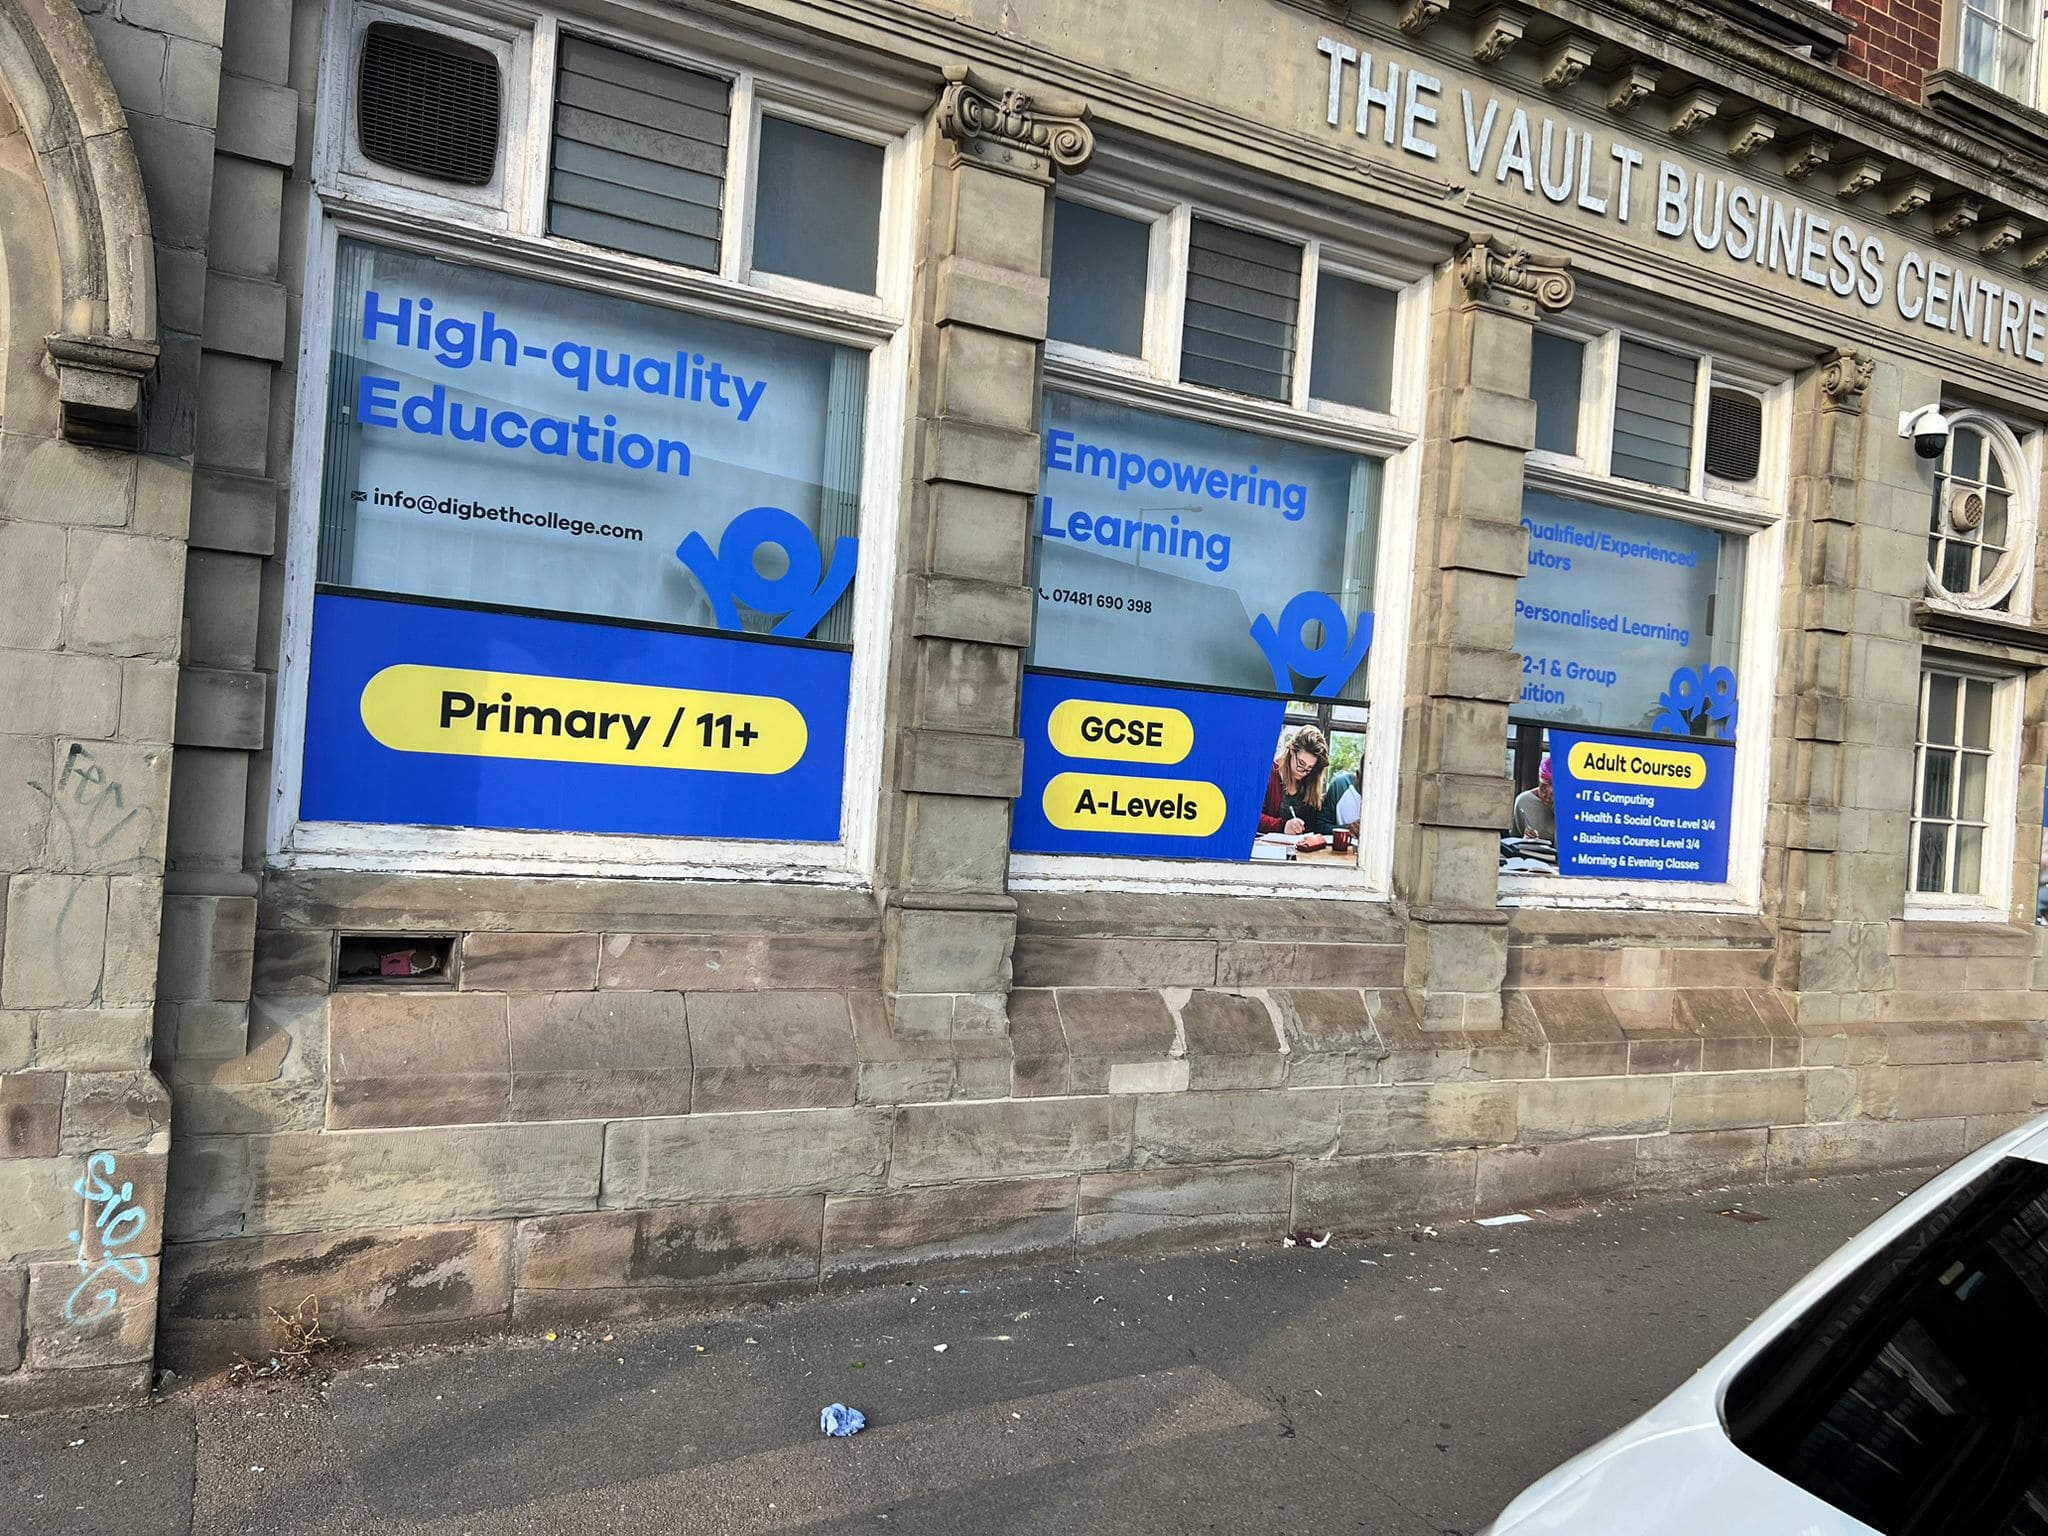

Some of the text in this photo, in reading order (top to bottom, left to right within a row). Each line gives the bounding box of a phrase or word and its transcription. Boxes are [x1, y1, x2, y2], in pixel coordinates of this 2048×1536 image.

[1317, 35, 2048, 363] THE VAULT BUSINESS CENTRE
[362, 290, 768, 422] High-quality
[356, 374, 693, 478] Education
[1046, 428, 1308, 523] Empowering
[373, 487, 644, 542] info@digbethcollege.com
[1041, 496, 1233, 574] Learning
[1528, 549, 1573, 572] utors
[1052, 588, 1153, 614] 07481 690 398
[1515, 599, 1691, 647] Personalised Learning
[1522, 655, 1617, 688] 2-1 & Group
[1520, 682, 1565, 705] uition
[439, 690, 759, 751] Primary / 11+
[1080, 716, 1164, 748] GCSE
[1583, 752, 1692, 779] Adult Courses
[1074, 788, 1198, 821] A-Levels
[1582, 790, 1655, 808] IT & Computing
[1581, 811, 1716, 831] Health & Social Care Level 3/4
[1579, 832, 1700, 850] Business Courses Level 3/4
[1578, 853, 1700, 870] Morning & Evening Classes
